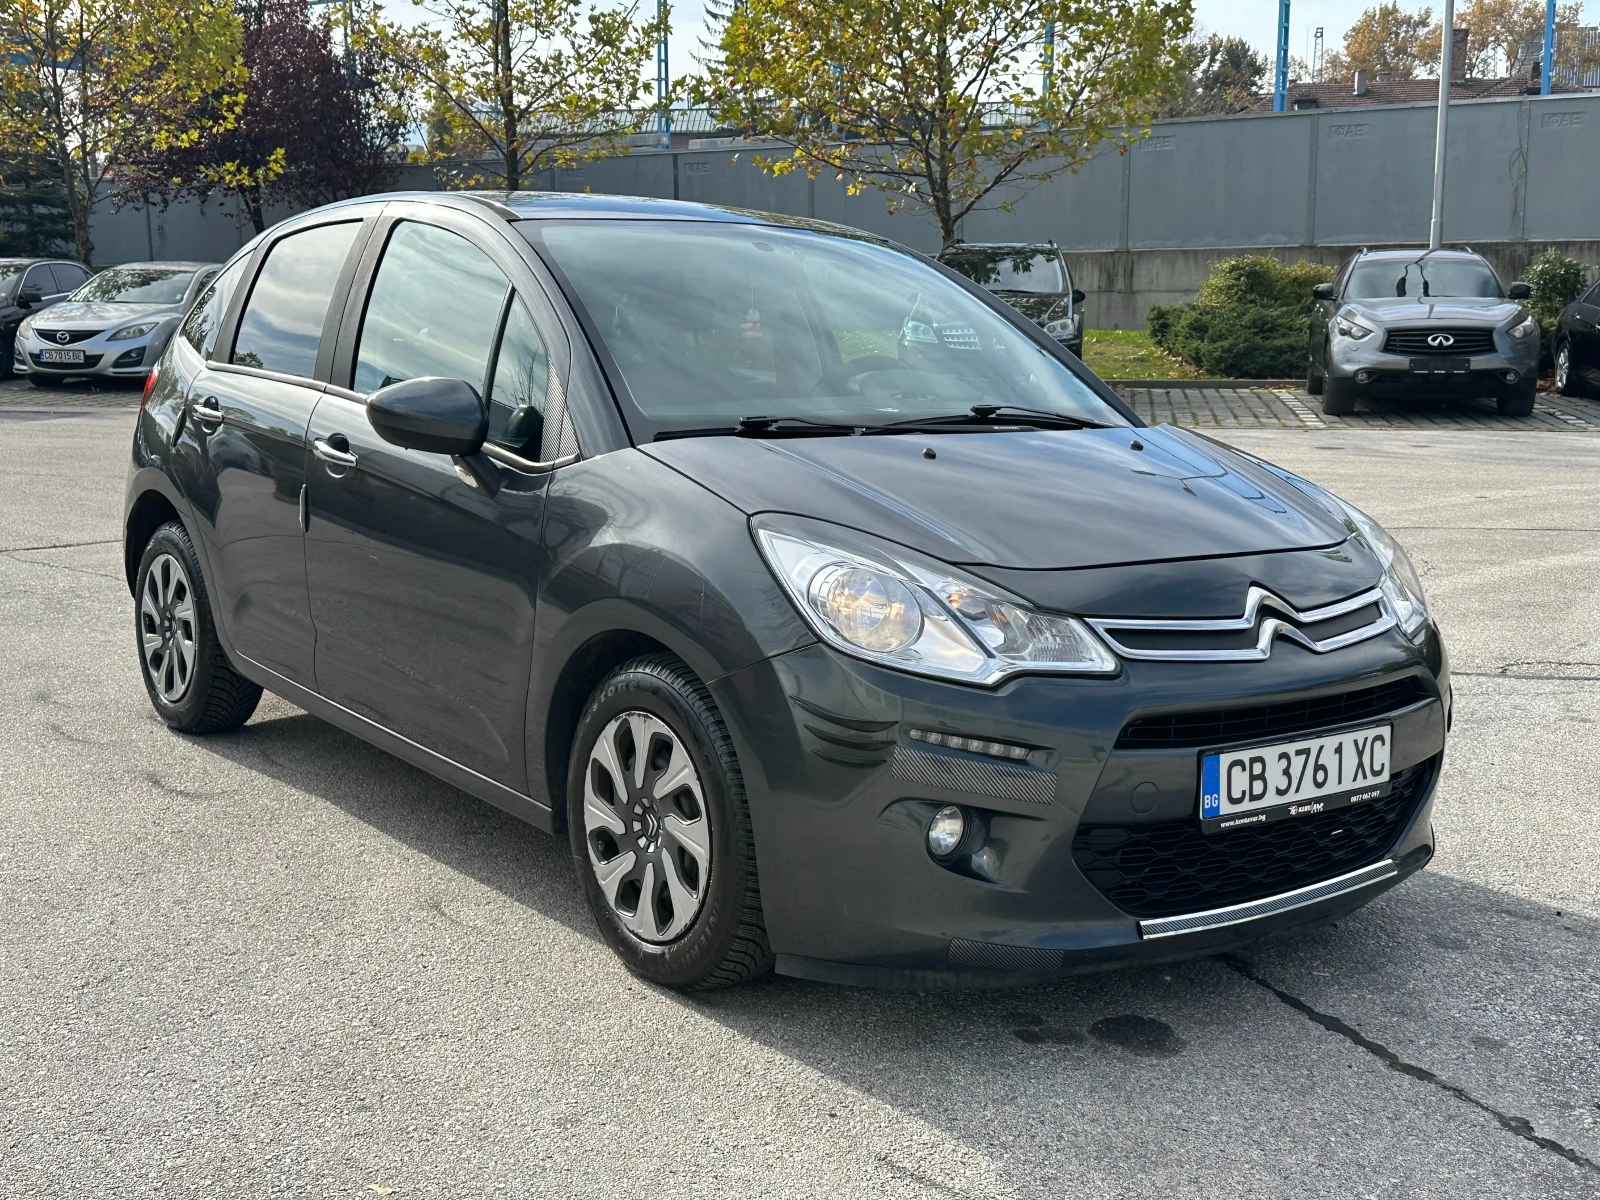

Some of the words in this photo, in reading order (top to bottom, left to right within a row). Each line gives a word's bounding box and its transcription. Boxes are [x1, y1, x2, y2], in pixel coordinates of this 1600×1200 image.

[54, 351, 72, 360] 7015
[72, 352, 82, 360] BE
[1226, 755, 1268, 806] CB
[1275, 741, 1344, 797] 3761
[1352, 734, 1386, 783] XC
[1204, 793, 1219, 809] BG
